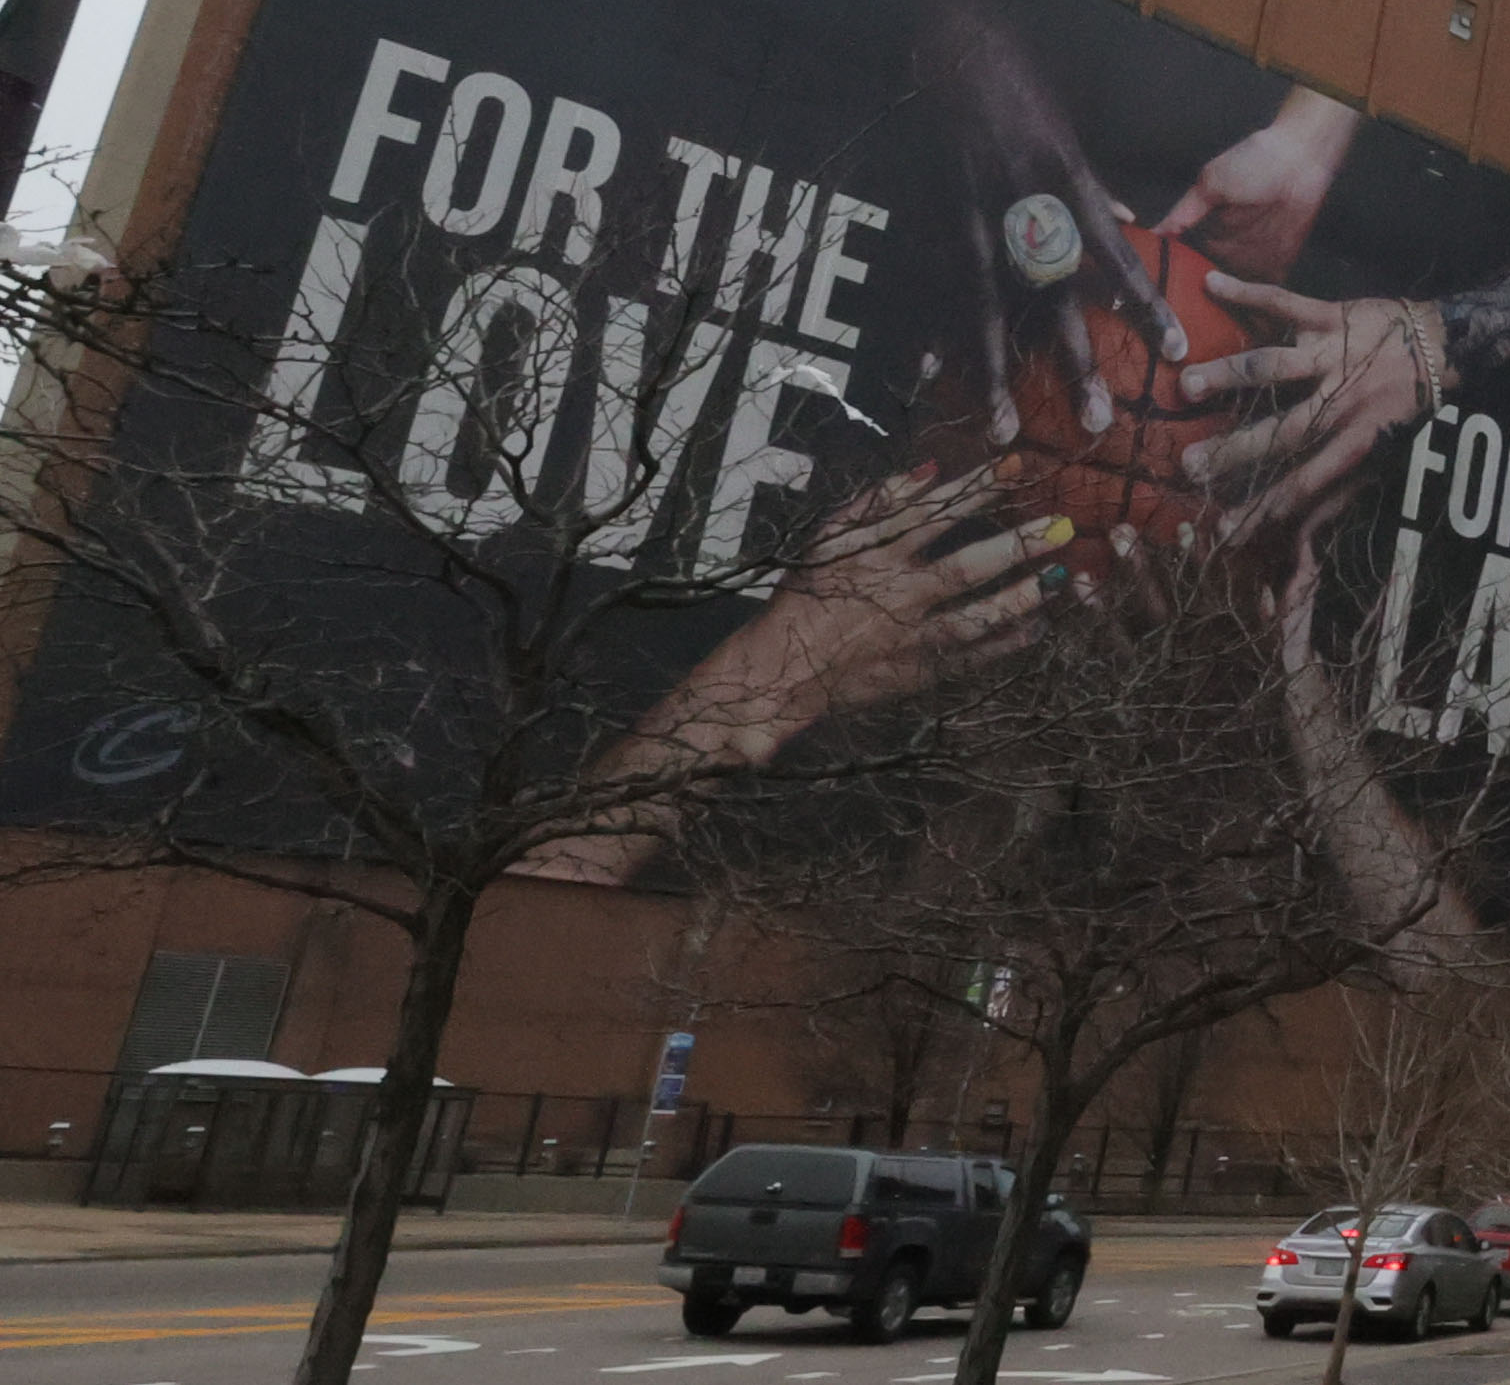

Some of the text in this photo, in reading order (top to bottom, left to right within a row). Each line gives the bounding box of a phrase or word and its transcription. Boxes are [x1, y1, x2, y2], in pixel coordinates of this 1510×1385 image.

[329, 38, 890, 349] FOR THE
[234, 215, 850, 600] LOVE
